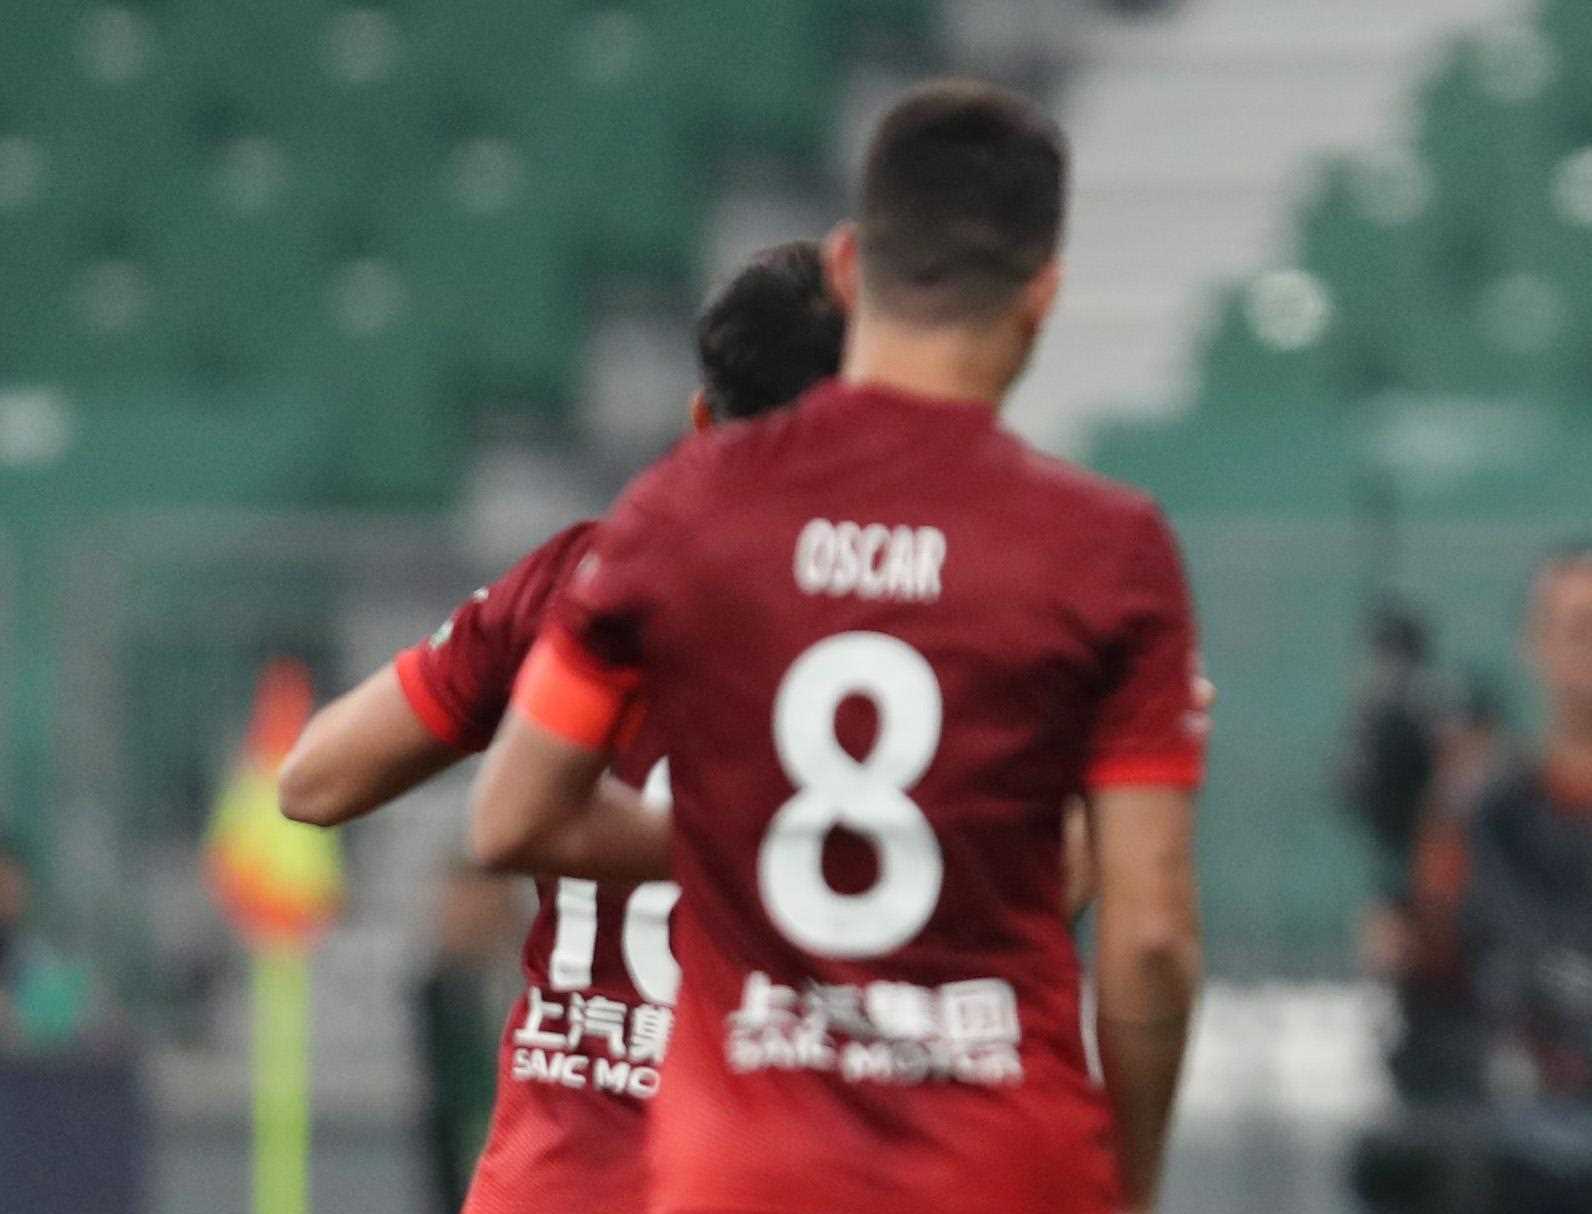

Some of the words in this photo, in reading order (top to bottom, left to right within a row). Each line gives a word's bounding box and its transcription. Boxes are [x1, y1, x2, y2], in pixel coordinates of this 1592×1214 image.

[794, 518, 947, 602] OSCAR
[759, 631, 943, 958] 8
[512, 1047, 589, 1088] SAIC
